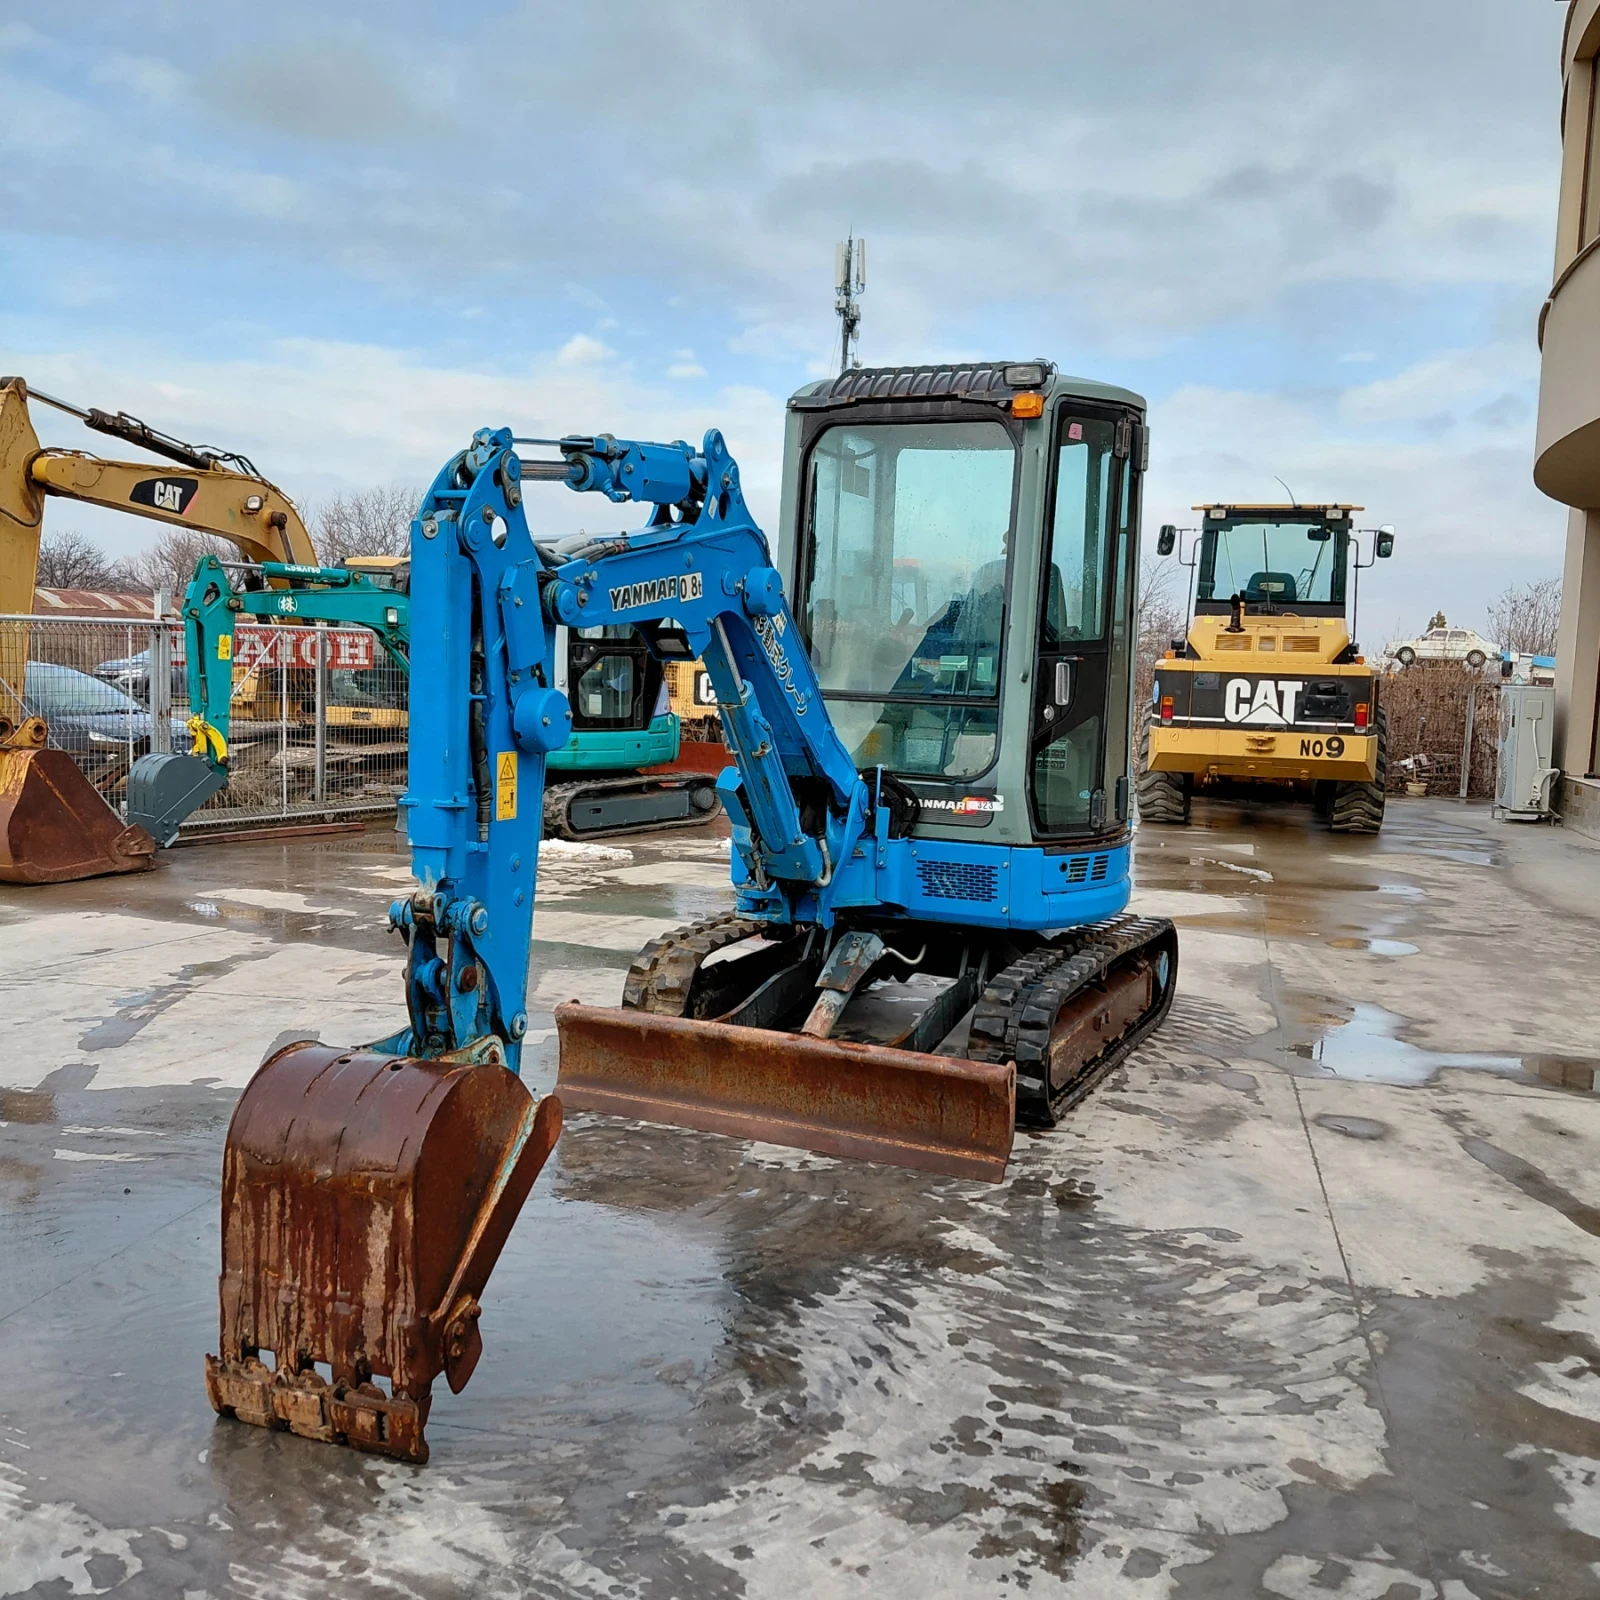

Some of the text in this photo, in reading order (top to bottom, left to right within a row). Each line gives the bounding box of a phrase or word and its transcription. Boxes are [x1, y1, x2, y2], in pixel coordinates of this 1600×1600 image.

[154, 481, 183, 511] CAT
[609, 576, 678, 612] YANMAR
[1225, 678, 1303, 725] CAT
